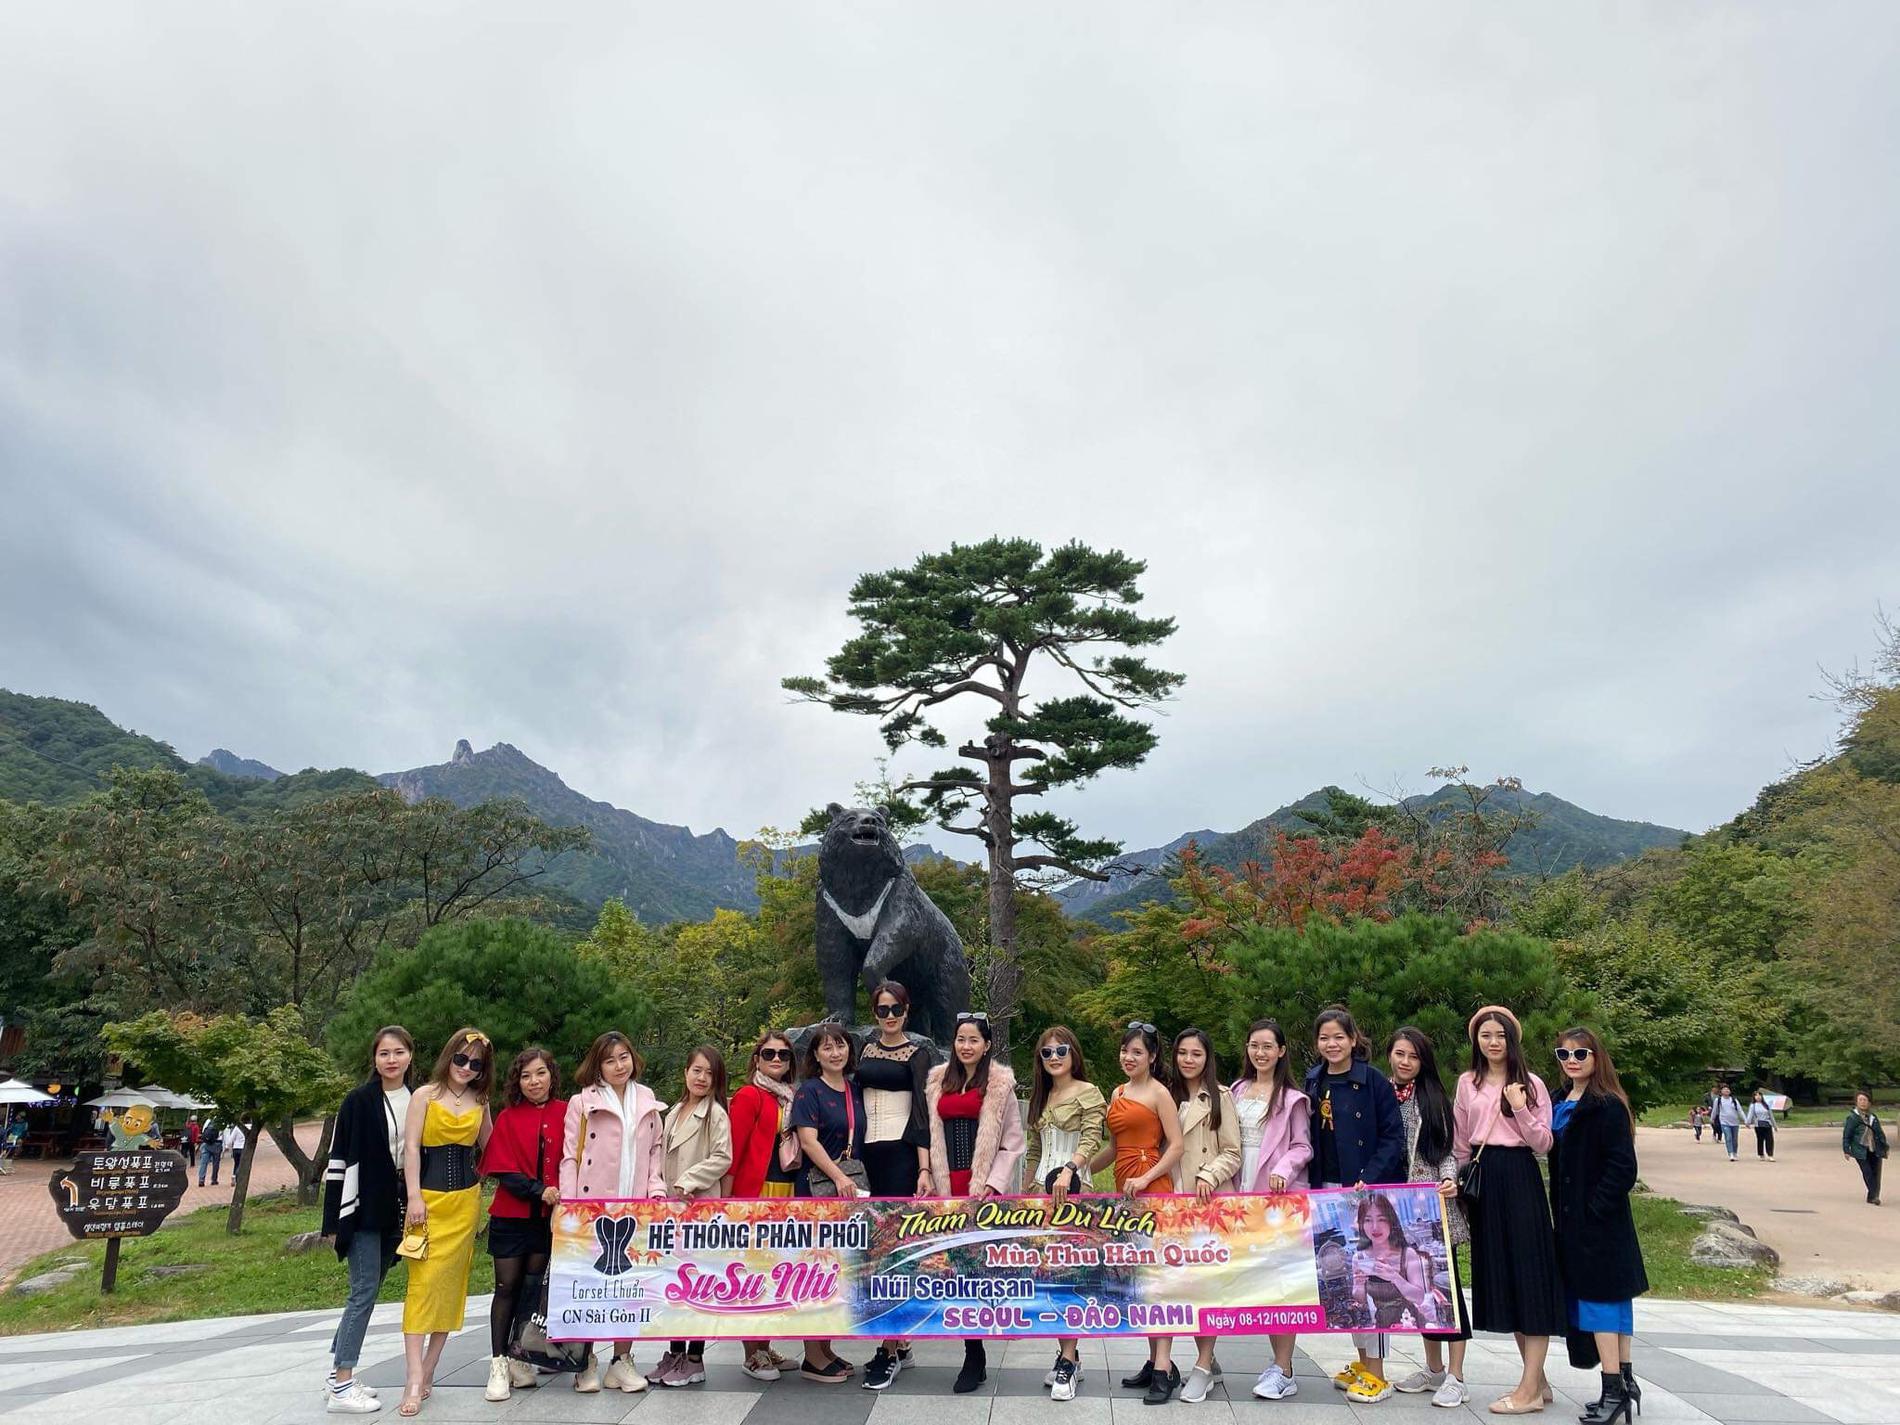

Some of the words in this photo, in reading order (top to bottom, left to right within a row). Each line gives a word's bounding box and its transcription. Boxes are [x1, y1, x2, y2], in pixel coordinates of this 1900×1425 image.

[91, 1176, 149, 1190] 비룡폭포
[898, 1210, 968, 1238] Tham
[976, 1204, 1043, 1228] Quan
[1052, 1204, 1091, 1227] Du
[1099, 1206, 1156, 1236] Lịch
[649, 1219, 674, 1255] HỆ
[682, 1216, 749, 1249] THỐNG
[756, 1217, 812, 1249] PHÂN
[819, 1213, 868, 1248] PHỐI
[987, 1243, 1040, 1267] Mùa
[1046, 1245, 1098, 1266] Thu
[1106, 1243, 1156, 1264] Hàn
[1164, 1240, 1229, 1267] Quốc
[572, 1279, 608, 1300] Corset
[613, 1278, 644, 1299] Chuẩn
[771, 1262, 839, 1303] Nhi
[872, 1277, 910, 1299] Núi
[915, 1277, 1033, 1298] Seokrasan
[562, 1310, 582, 1324] CN
[585, 1308, 606, 1324] Sài
[609, 1308, 637, 1324] Gòn
[639, 1308, 651, 1322] II
[945, 1308, 1030, 1328] SEOUL
[1067, 1299, 1122, 1327] ĐẢO
[1130, 1305, 1194, 1326] NAMI
[1207, 1314, 1236, 1328] Ngày
[1239, 1312, 1318, 1326] 08-12/10/2019
